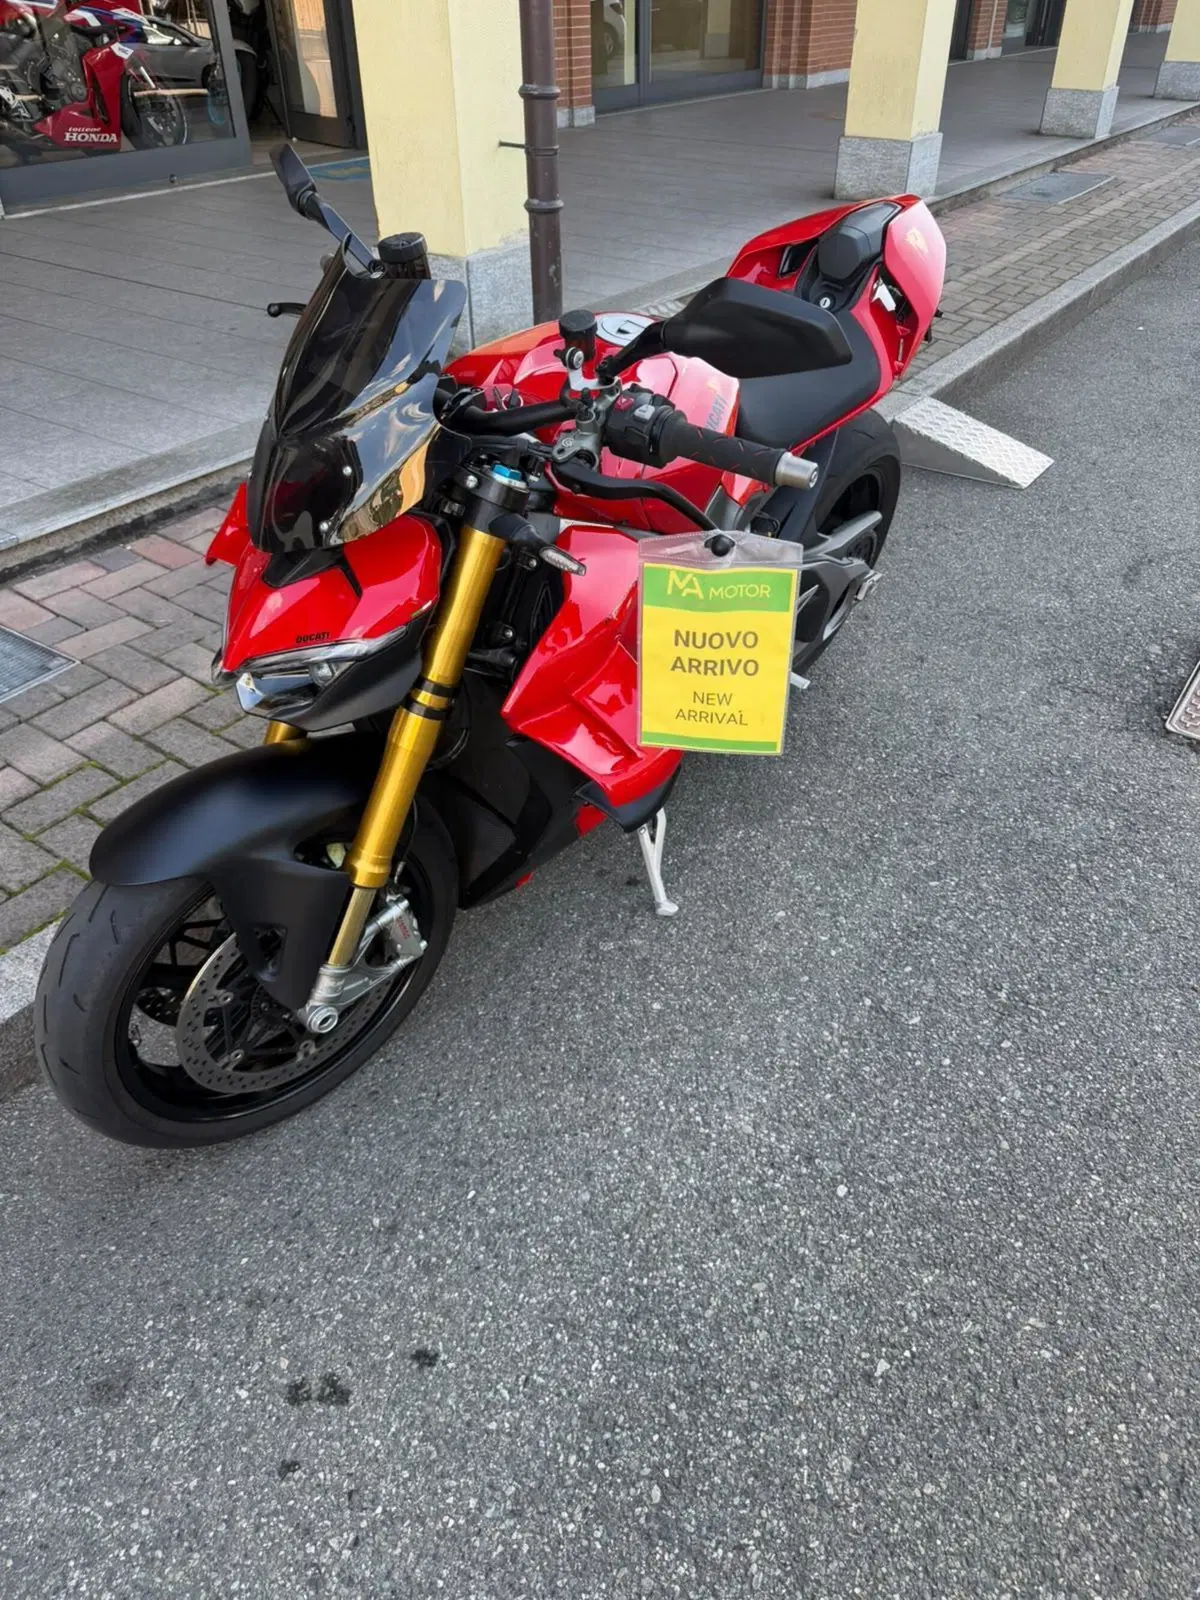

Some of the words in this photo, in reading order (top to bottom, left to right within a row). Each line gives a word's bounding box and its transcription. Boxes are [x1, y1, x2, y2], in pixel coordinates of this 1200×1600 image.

[64, 132, 118, 143] HONDA
[667, 570, 704, 600] MA
[709, 584, 771, 600] MOTOR
[295, 631, 330, 644] DUCATI
[673, 629, 759, 650] NUOVO
[670, 656, 760, 677] ARRIVO
[692, 691, 733, 707] NEW
[675, 708, 749, 727] ARRIVAL
